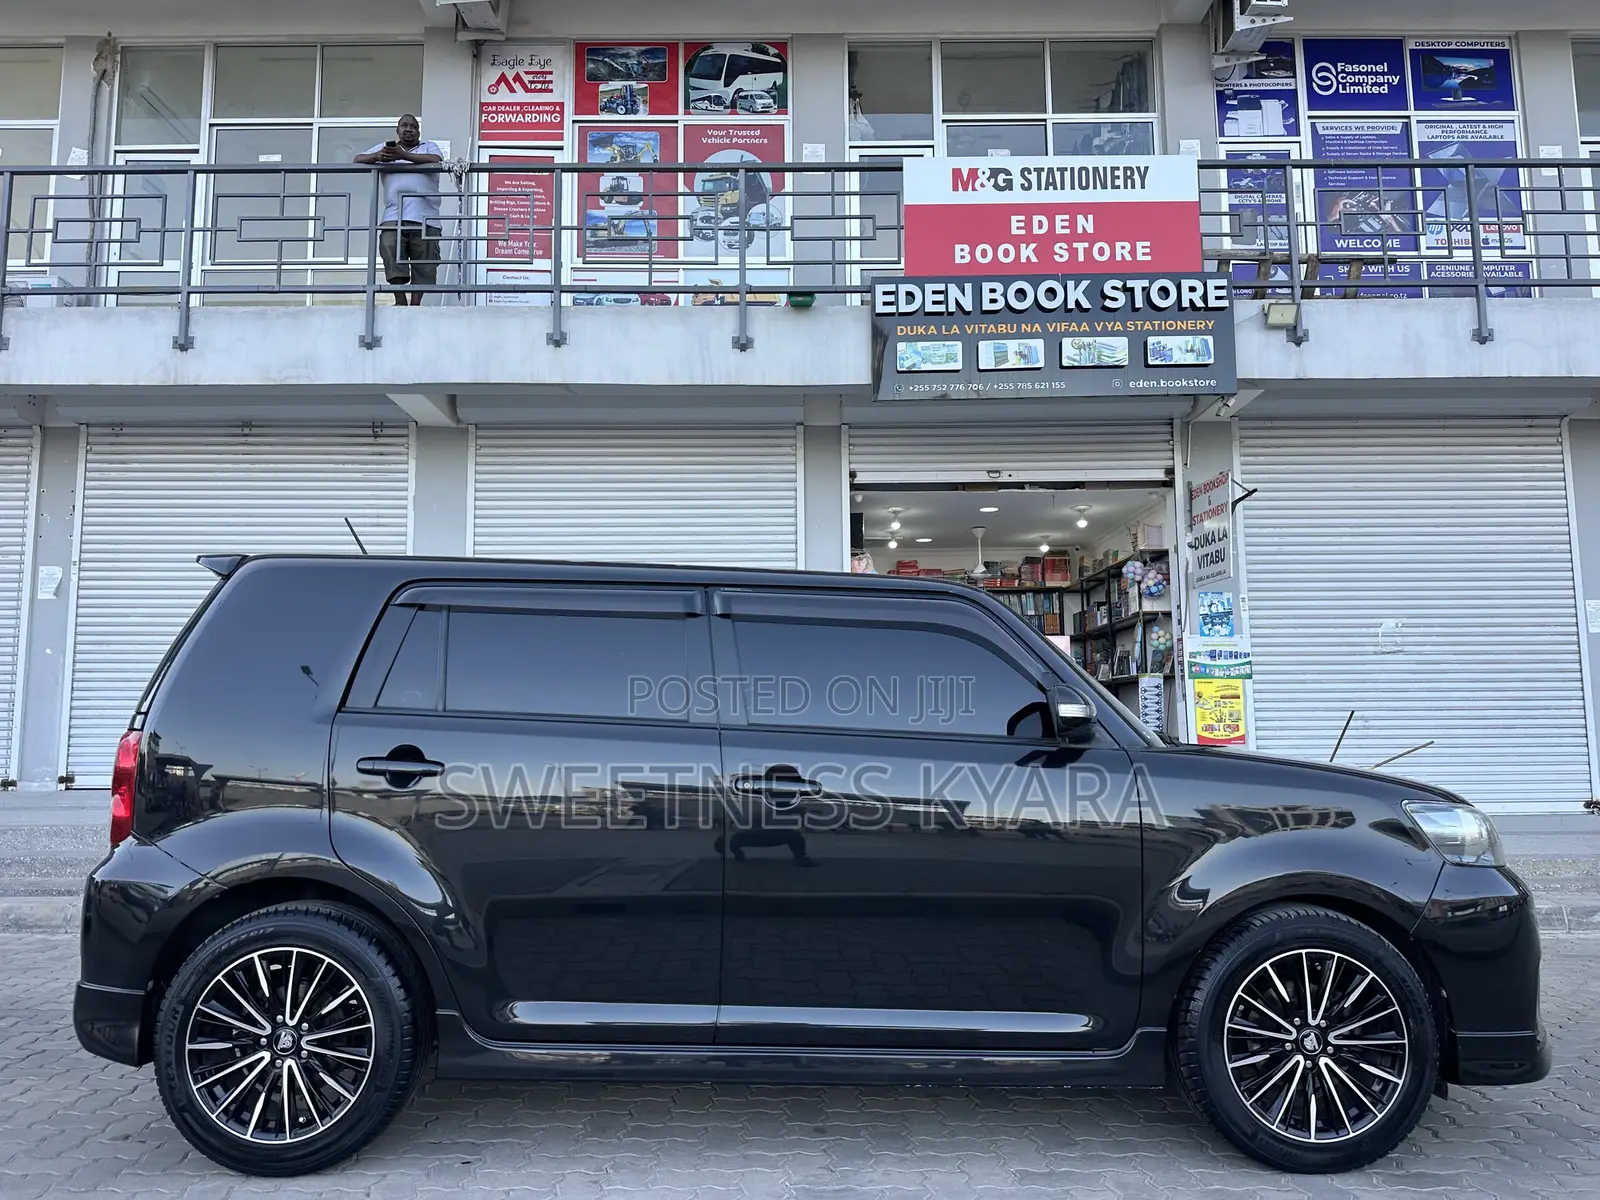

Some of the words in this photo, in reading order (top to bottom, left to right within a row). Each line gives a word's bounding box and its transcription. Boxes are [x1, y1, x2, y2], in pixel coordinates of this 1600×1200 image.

[490, 54, 525, 70] Eagle
[528, 54, 552, 70] Eye
[1337, 62, 1388, 72] Fasonel
[1338, 73, 1400, 85] Company
[1338, 83, 1388, 94] Limited
[482, 114, 560, 123] FORWARDING
[952, 167, 1014, 192] M&G
[1020, 166, 1150, 192] STATIONERY
[1010, 214, 1095, 235] EDEN
[954, 242, 1039, 264] BOOK
[1054, 241, 1152, 262] STORE
[874, 282, 972, 315] EDEN
[981, 280, 1092, 312] BOOK
[1102, 278, 1230, 311] STORE
[897, 325, 937, 336] DUKA
[942, 324, 960, 335] LA
[964, 323, 1016, 334] VITABU
[1021, 323, 1042, 333] NA
[1046, 322, 1090, 332] VIFAA
[1094, 321, 1123, 331] VYA
[1126, 320, 1215, 331] STATIONERY
[1129, 378, 1217, 388] eden.bookstore
[1192, 486, 1203, 500] EDEN
[1193, 501, 1228, 526] STATIONERY
[1194, 530, 1216, 550] DUKA
[1218, 526, 1228, 540] LA
[1197, 547, 1225, 570] VITABU
